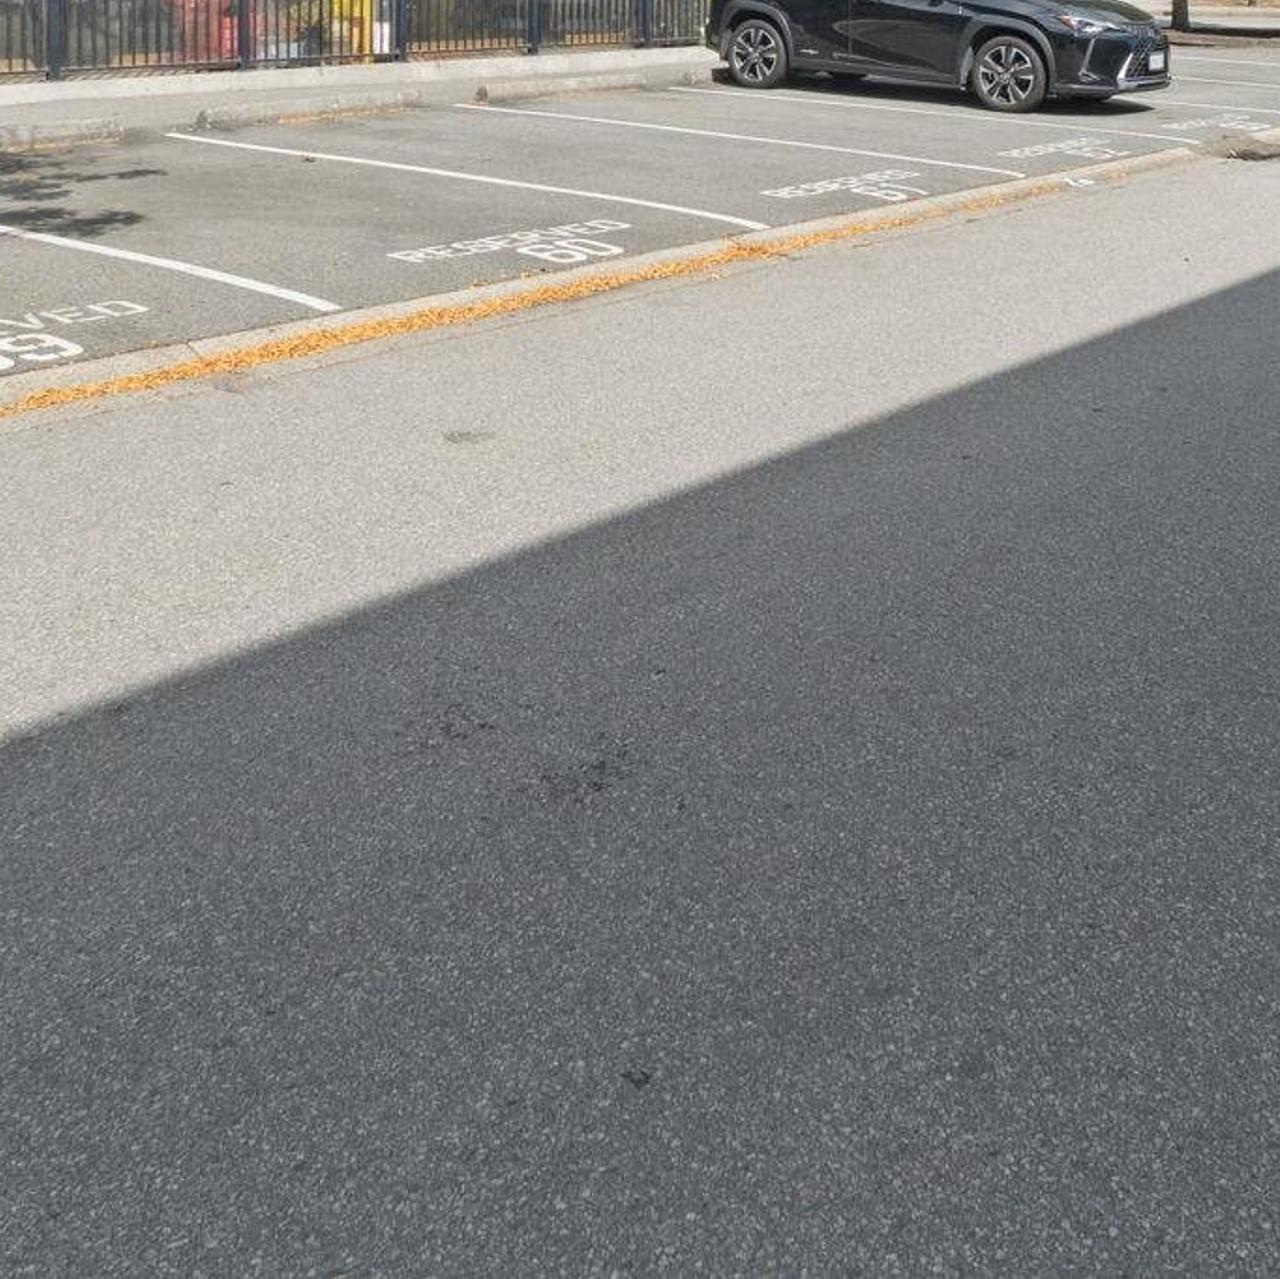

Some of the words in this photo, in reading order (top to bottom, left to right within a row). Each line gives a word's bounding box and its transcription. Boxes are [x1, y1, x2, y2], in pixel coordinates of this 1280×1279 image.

[850, 182, 930, 201] 61
[385, 219, 632, 263] RESERVED
[516, 238, 625, 263] 60
